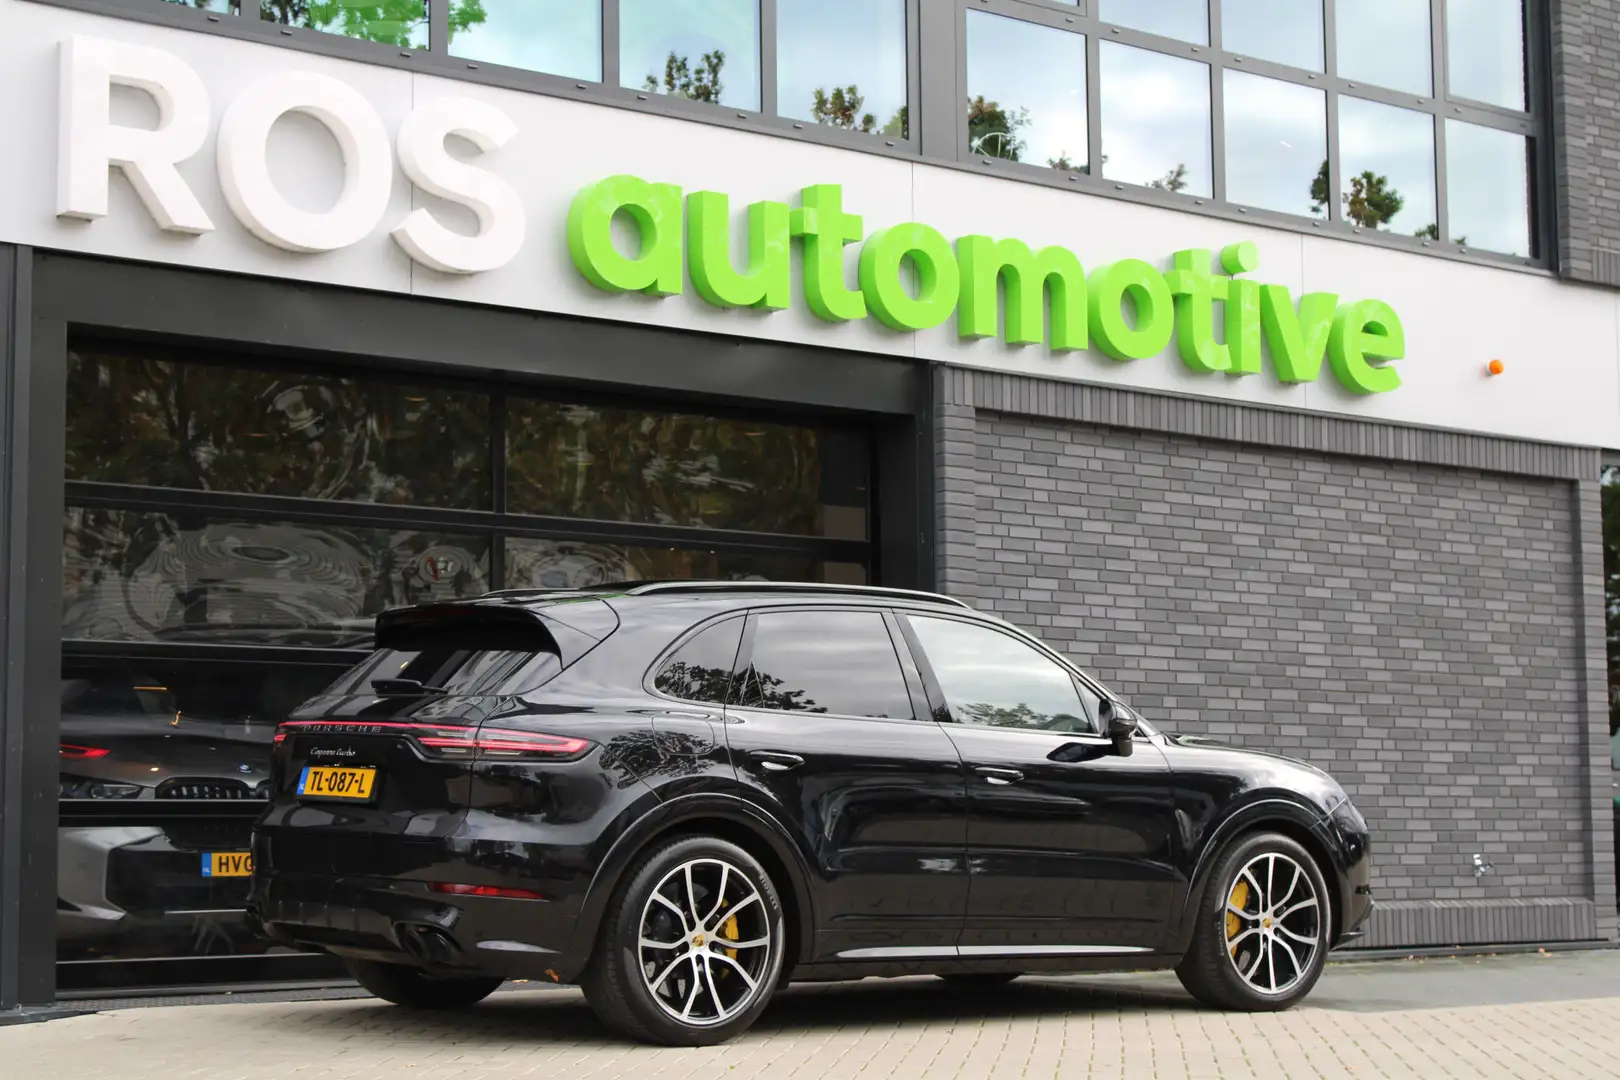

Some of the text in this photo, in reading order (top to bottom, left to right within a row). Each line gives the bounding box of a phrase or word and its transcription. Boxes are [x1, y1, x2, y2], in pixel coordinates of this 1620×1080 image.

[57, 34, 1405, 394] ROS automotive
[301, 724, 382, 733] PORSCHE
[310, 771, 365, 794] TL-087-L
